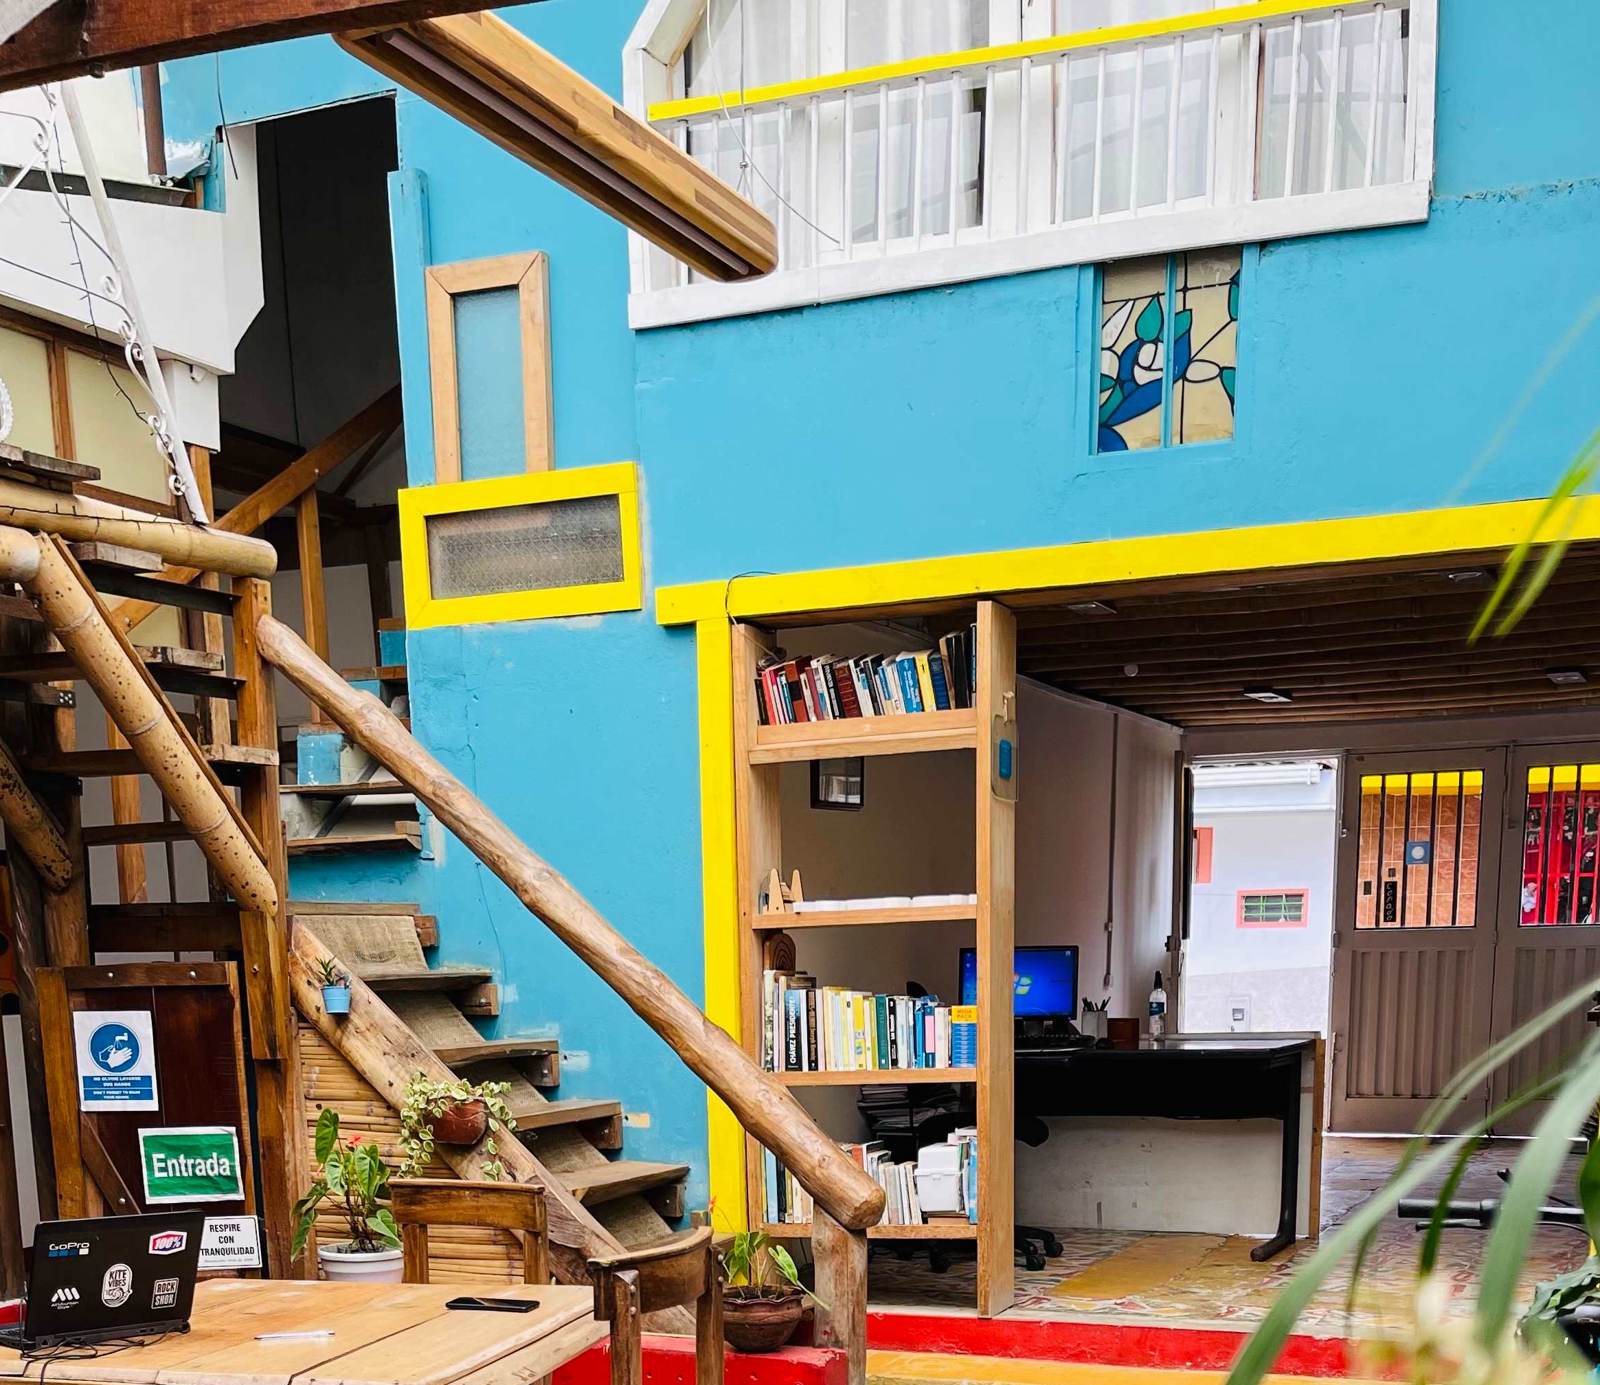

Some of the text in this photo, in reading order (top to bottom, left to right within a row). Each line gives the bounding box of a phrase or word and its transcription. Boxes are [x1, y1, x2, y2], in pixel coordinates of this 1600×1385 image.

[152, 1152, 231, 1178] Entrada
[209, 1223, 241, 1233] RESPIRE
[155, 1236, 181, 1249] 100%
[218, 1235, 235, 1244] CON
[49, 1242, 90, 1251] GoPro
[200, 1247, 255, 1257] TRANQUILIDAD
[109, 1269, 128, 1281] KITE
[108, 1279, 127, 1288] VIBES
[157, 1282, 175, 1293] ROCK
